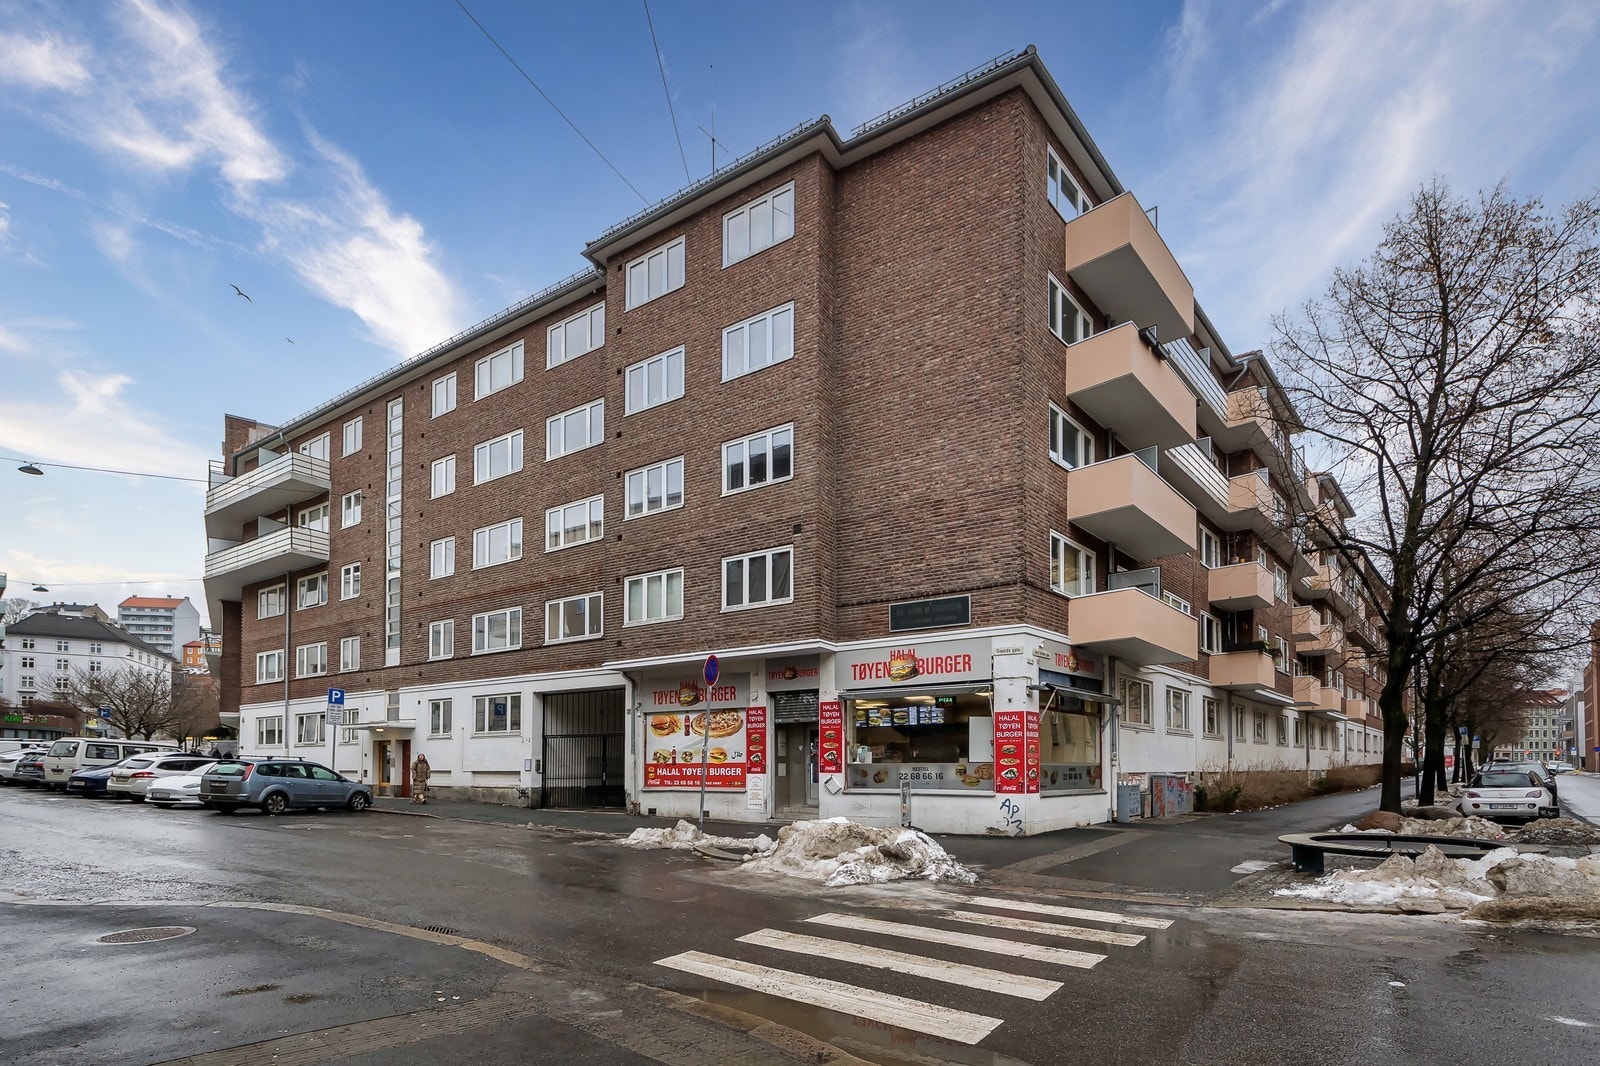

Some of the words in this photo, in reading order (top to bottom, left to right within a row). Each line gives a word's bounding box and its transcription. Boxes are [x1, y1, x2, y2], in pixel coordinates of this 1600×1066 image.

[890, 649, 916, 661] HALAL
[796, 668, 818, 677] BURGER
[851, 661, 891, 680] TØYEN
[917, 654, 972, 675] BURGER
[332, 691, 341, 702] P
[653, 690, 680, 705] TØYEN
[657, 767, 680, 776] HALAL
[682, 767, 706, 776] TØYE
[709, 767, 741, 776] BURGER
